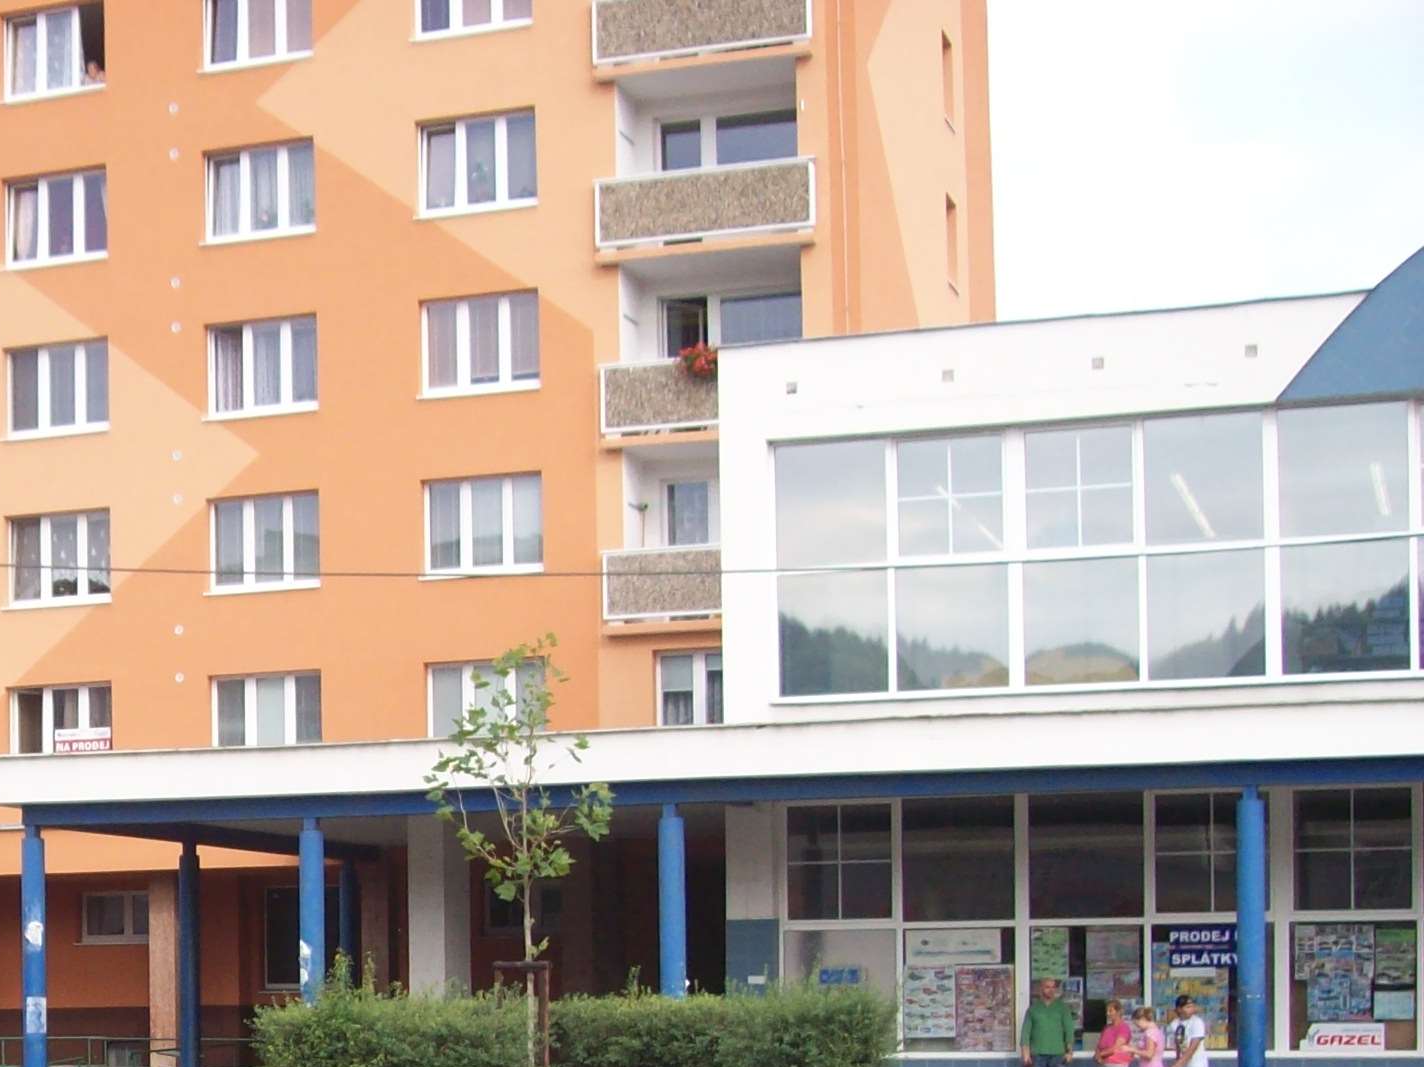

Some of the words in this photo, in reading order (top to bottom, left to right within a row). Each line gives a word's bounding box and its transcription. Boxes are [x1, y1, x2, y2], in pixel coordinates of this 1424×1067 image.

[56, 742, 71, 752] NA
[72, 740, 110, 751] PRODEJ
[1169, 930, 1229, 943] PRODEJ
[1316, 1034, 1381, 1046] GAZEL
